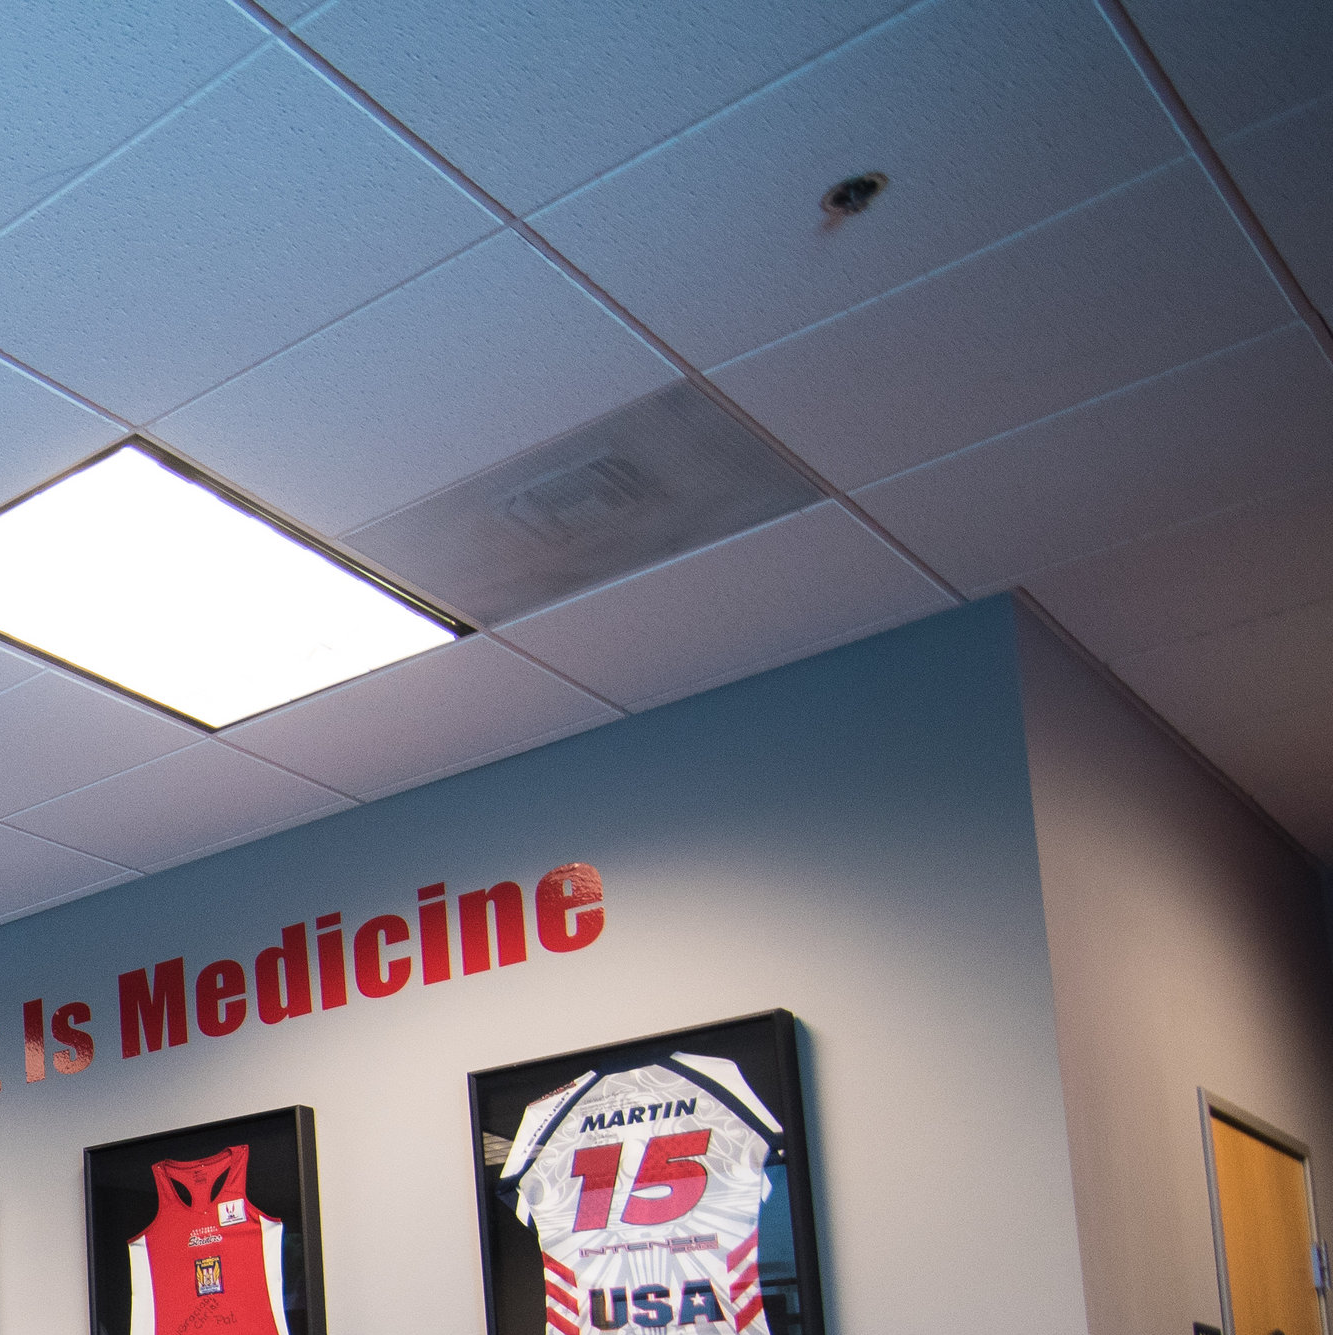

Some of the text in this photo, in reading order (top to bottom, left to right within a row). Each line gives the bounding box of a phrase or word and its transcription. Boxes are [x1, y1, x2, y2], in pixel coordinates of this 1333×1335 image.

[22, 998, 95, 1084] Is
[117, 861, 606, 1060] Medicine
[579, 1097, 697, 1134] MARTIN
[570, 1128, 712, 1233] 15
[588, 1277, 727, 1331] USA
